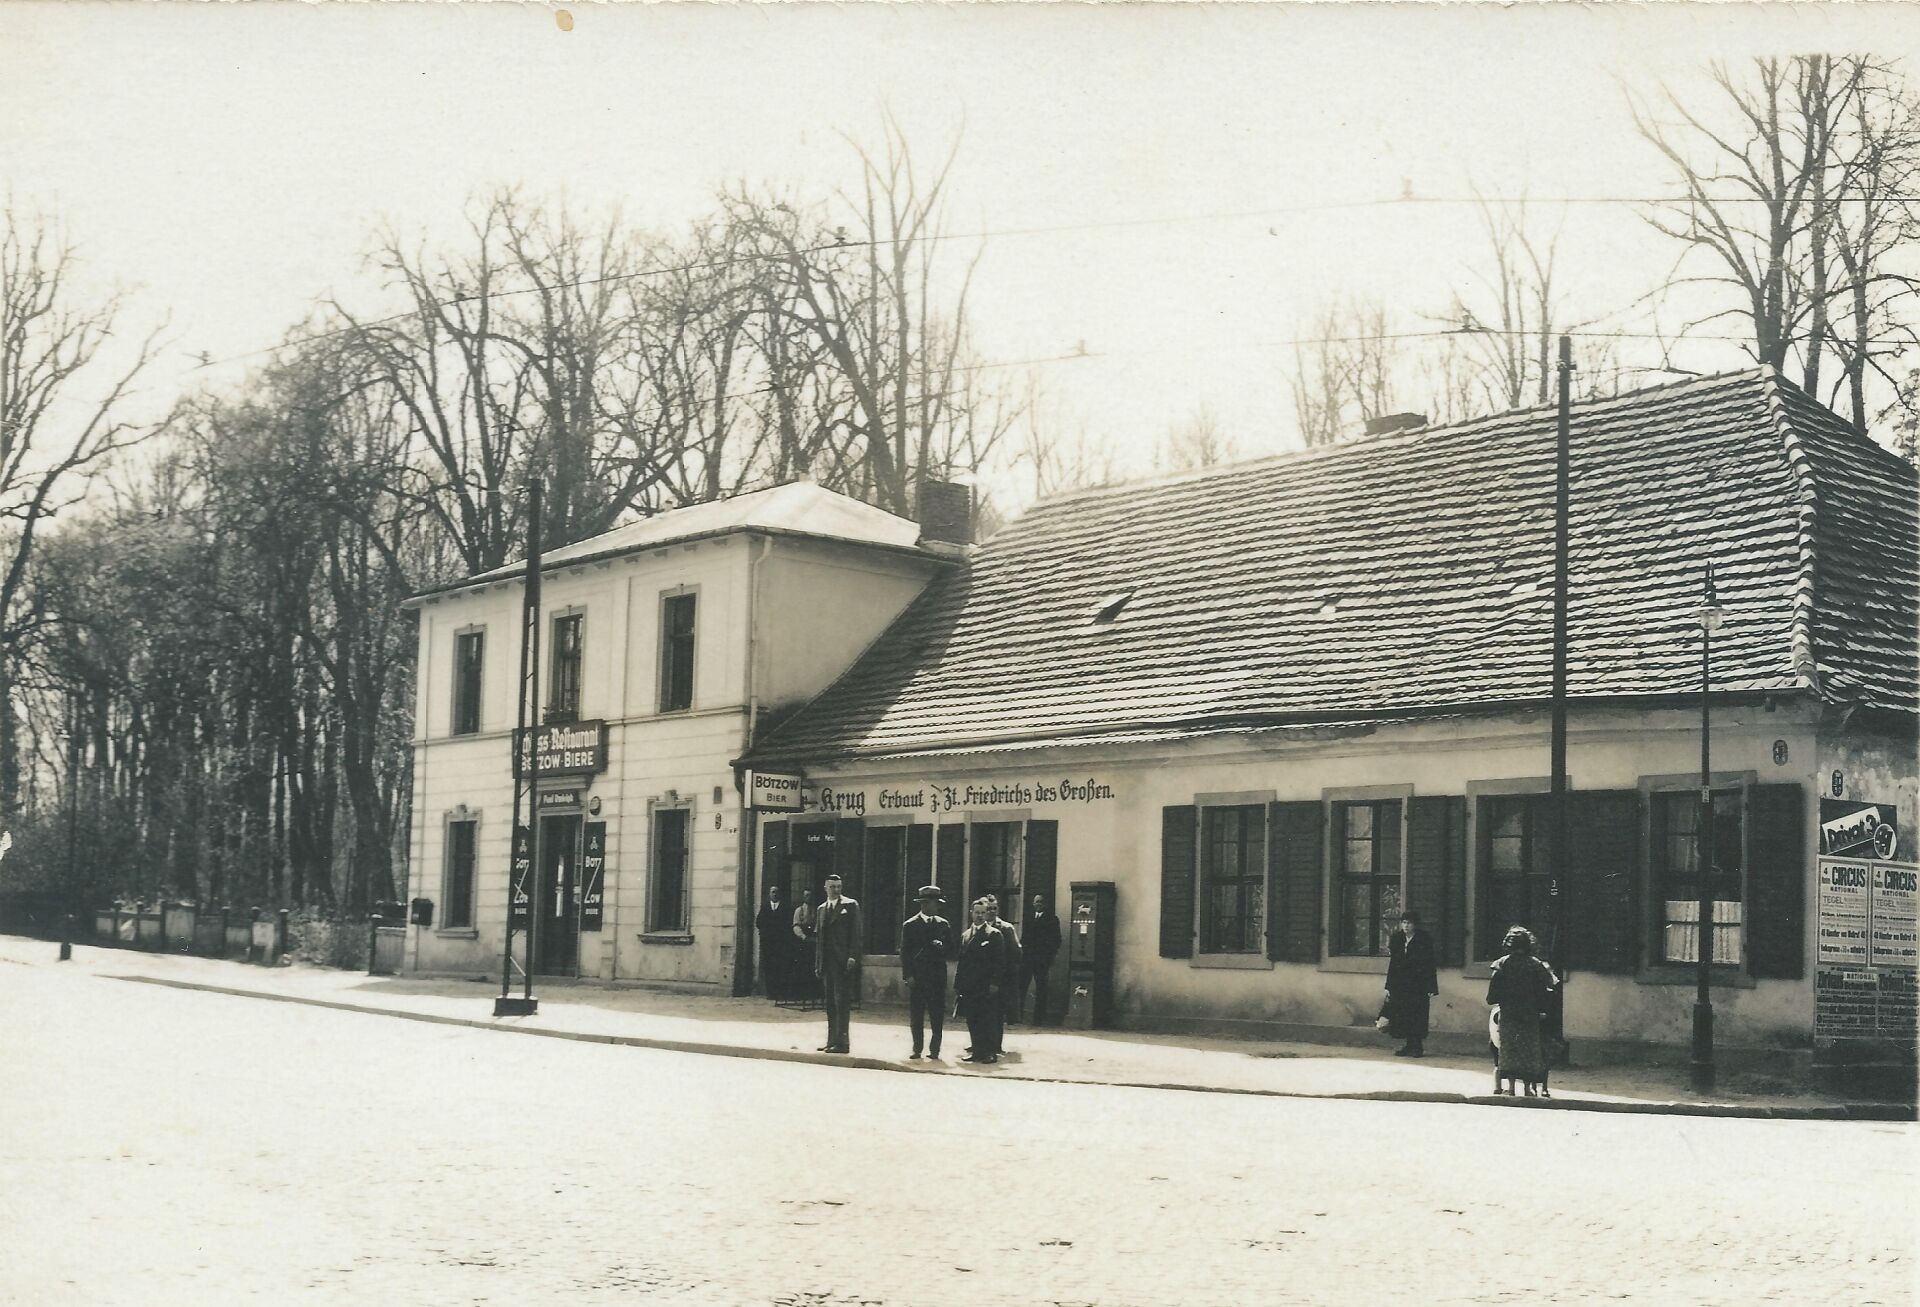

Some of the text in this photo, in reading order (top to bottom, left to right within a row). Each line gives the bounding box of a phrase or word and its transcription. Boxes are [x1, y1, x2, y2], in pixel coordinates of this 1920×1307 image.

[755, 775, 800, 791] BÖTZOW
[766, 793, 787, 803] BIER
[820, 787, 866, 816] Krug
[878, 789, 924, 809] Erbaut
[963, 782, 1032, 807] Friedrichs
[1035, 780, 1057, 802] des
[1060, 777, 1115, 804] Großen.
[1832, 866, 1866, 888] CIRCUS
[1884, 870, 1917, 892] CIRCUS
[1830, 886, 1858, 894] NATIONAL
[1881, 890, 1910, 898] NATIONAL
[1822, 895, 1844, 904] TEGEL
[1875, 898, 1896, 908] TEGEL
[1846, 972, 1875, 981] NATIONAL
